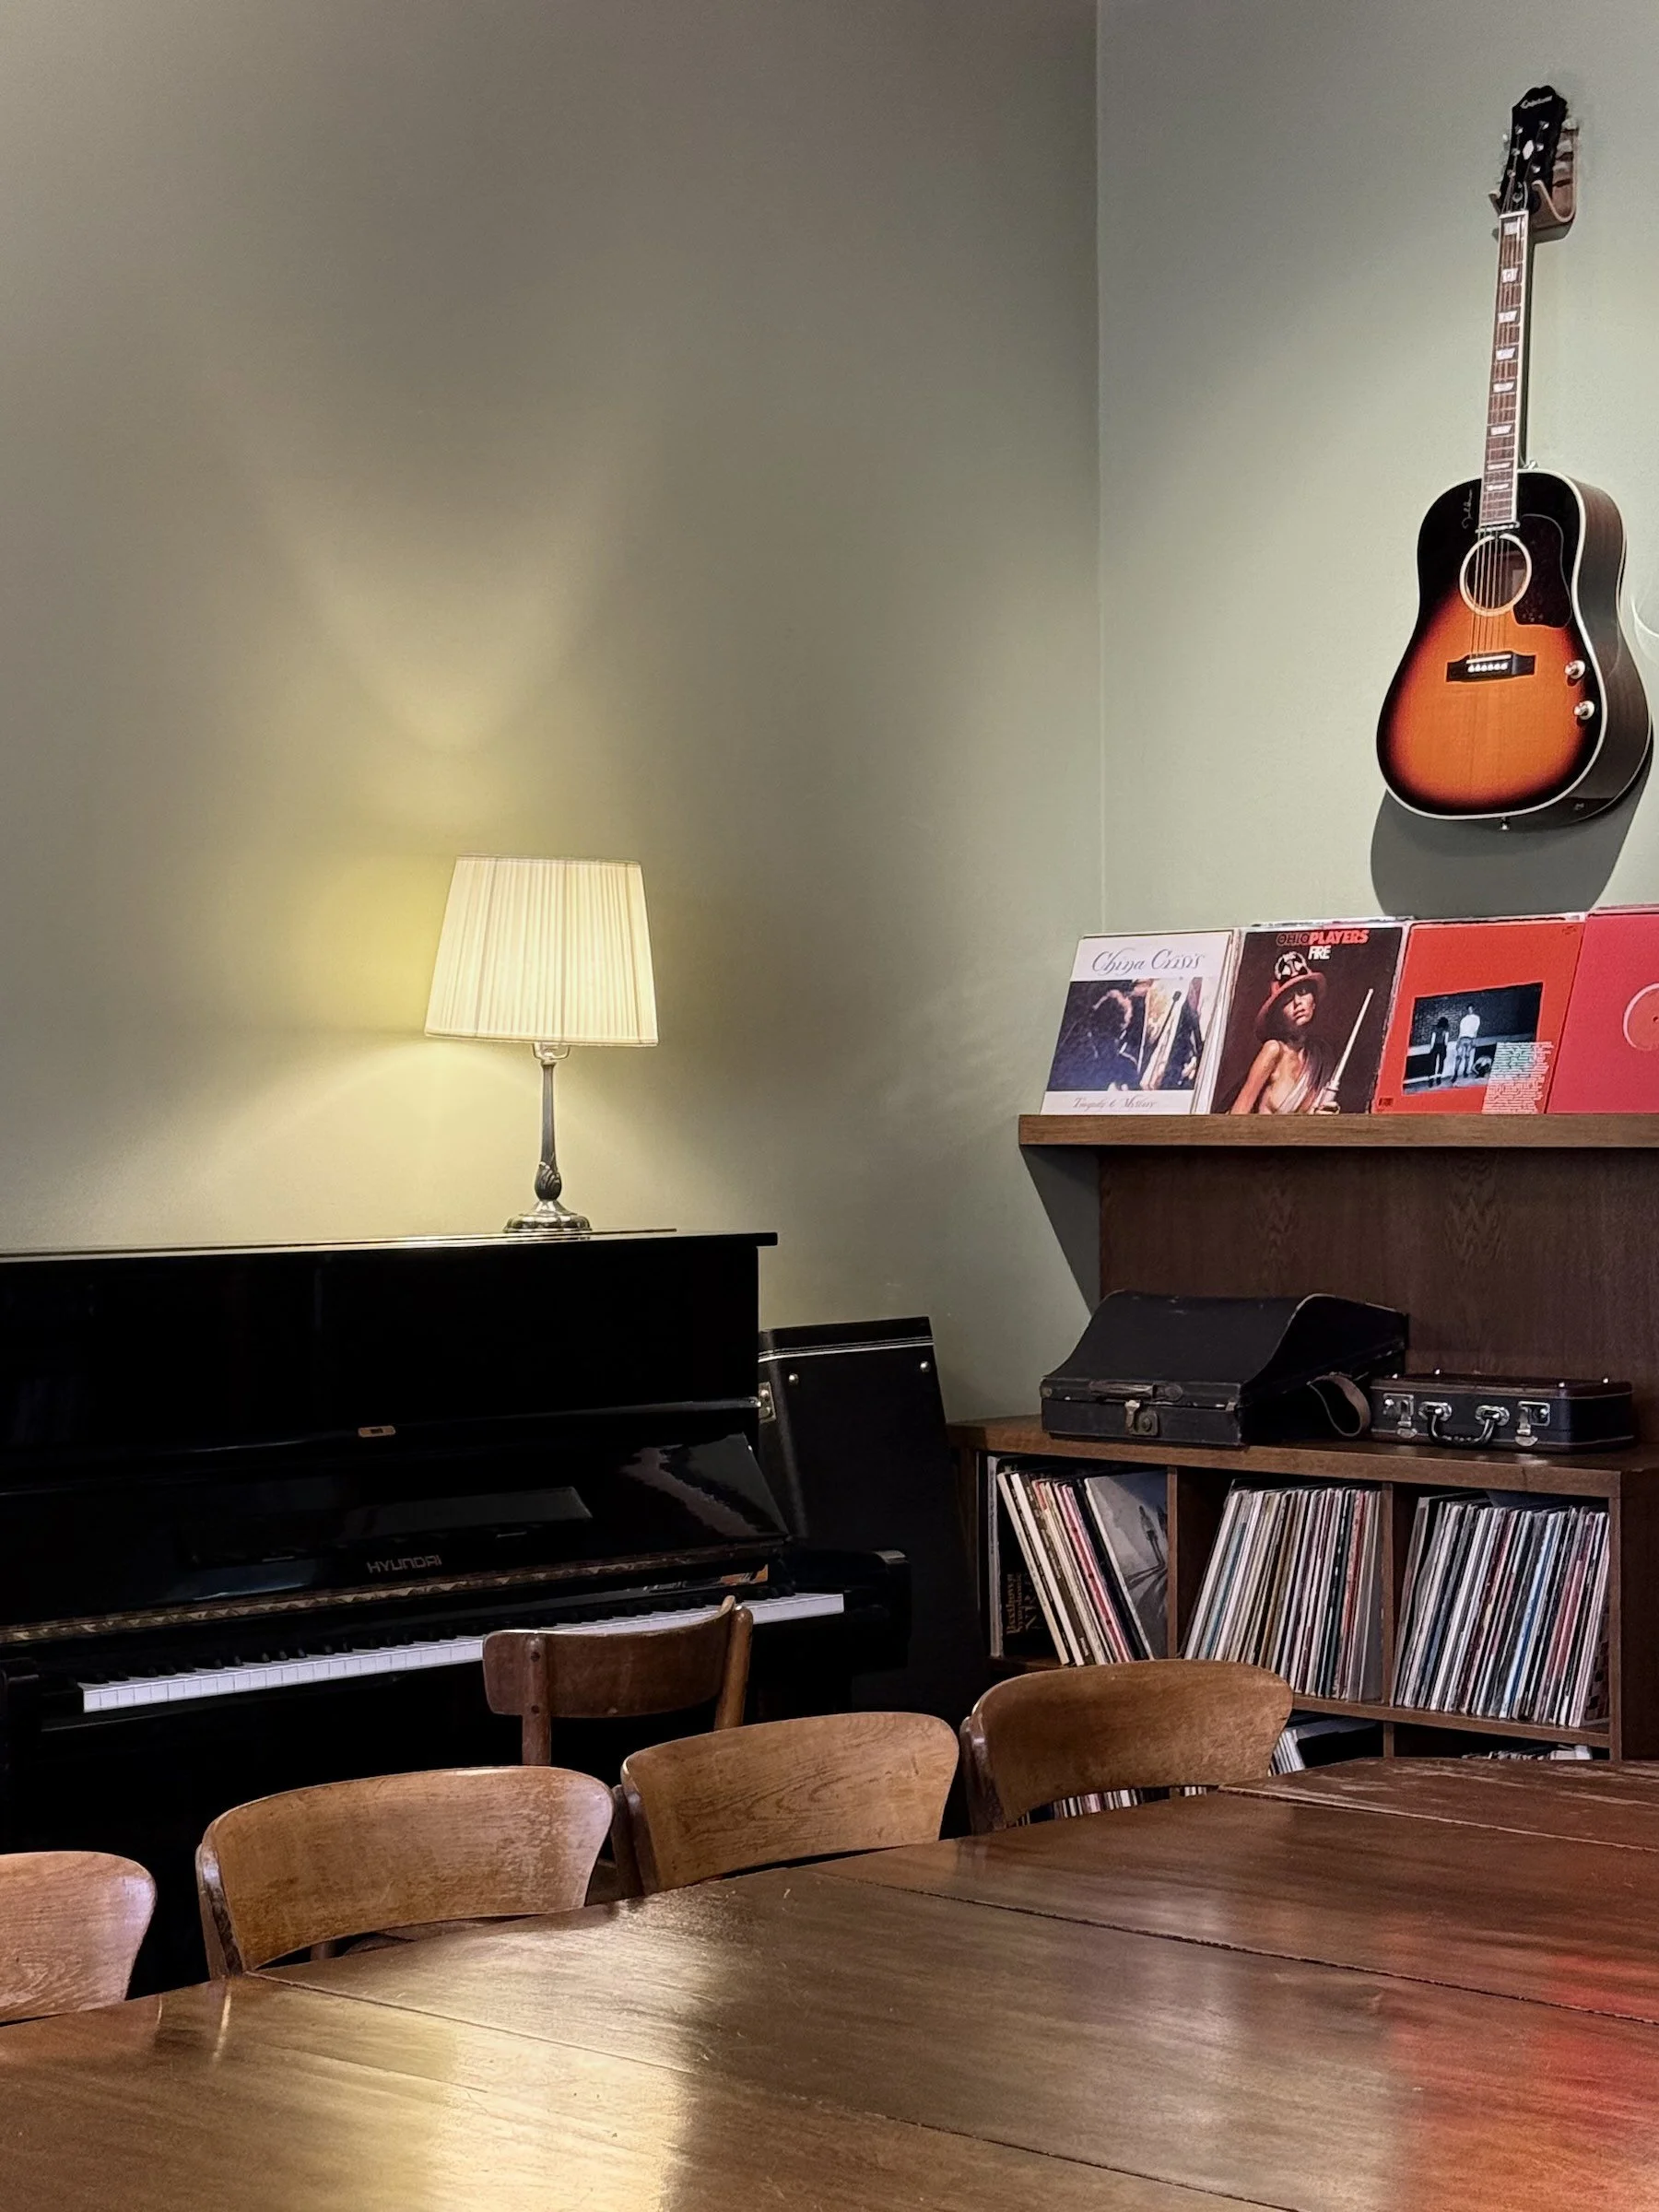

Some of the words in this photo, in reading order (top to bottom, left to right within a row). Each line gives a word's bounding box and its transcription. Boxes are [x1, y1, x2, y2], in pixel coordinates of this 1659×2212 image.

[1276, 932, 1309, 947] OHIO
[1309, 929, 1370, 946] PLAYERS
[1091, 947, 1146, 977] China
[1151, 948, 1206, 970] Crisis
[366, 1554, 442, 1574] HYUNDAI
